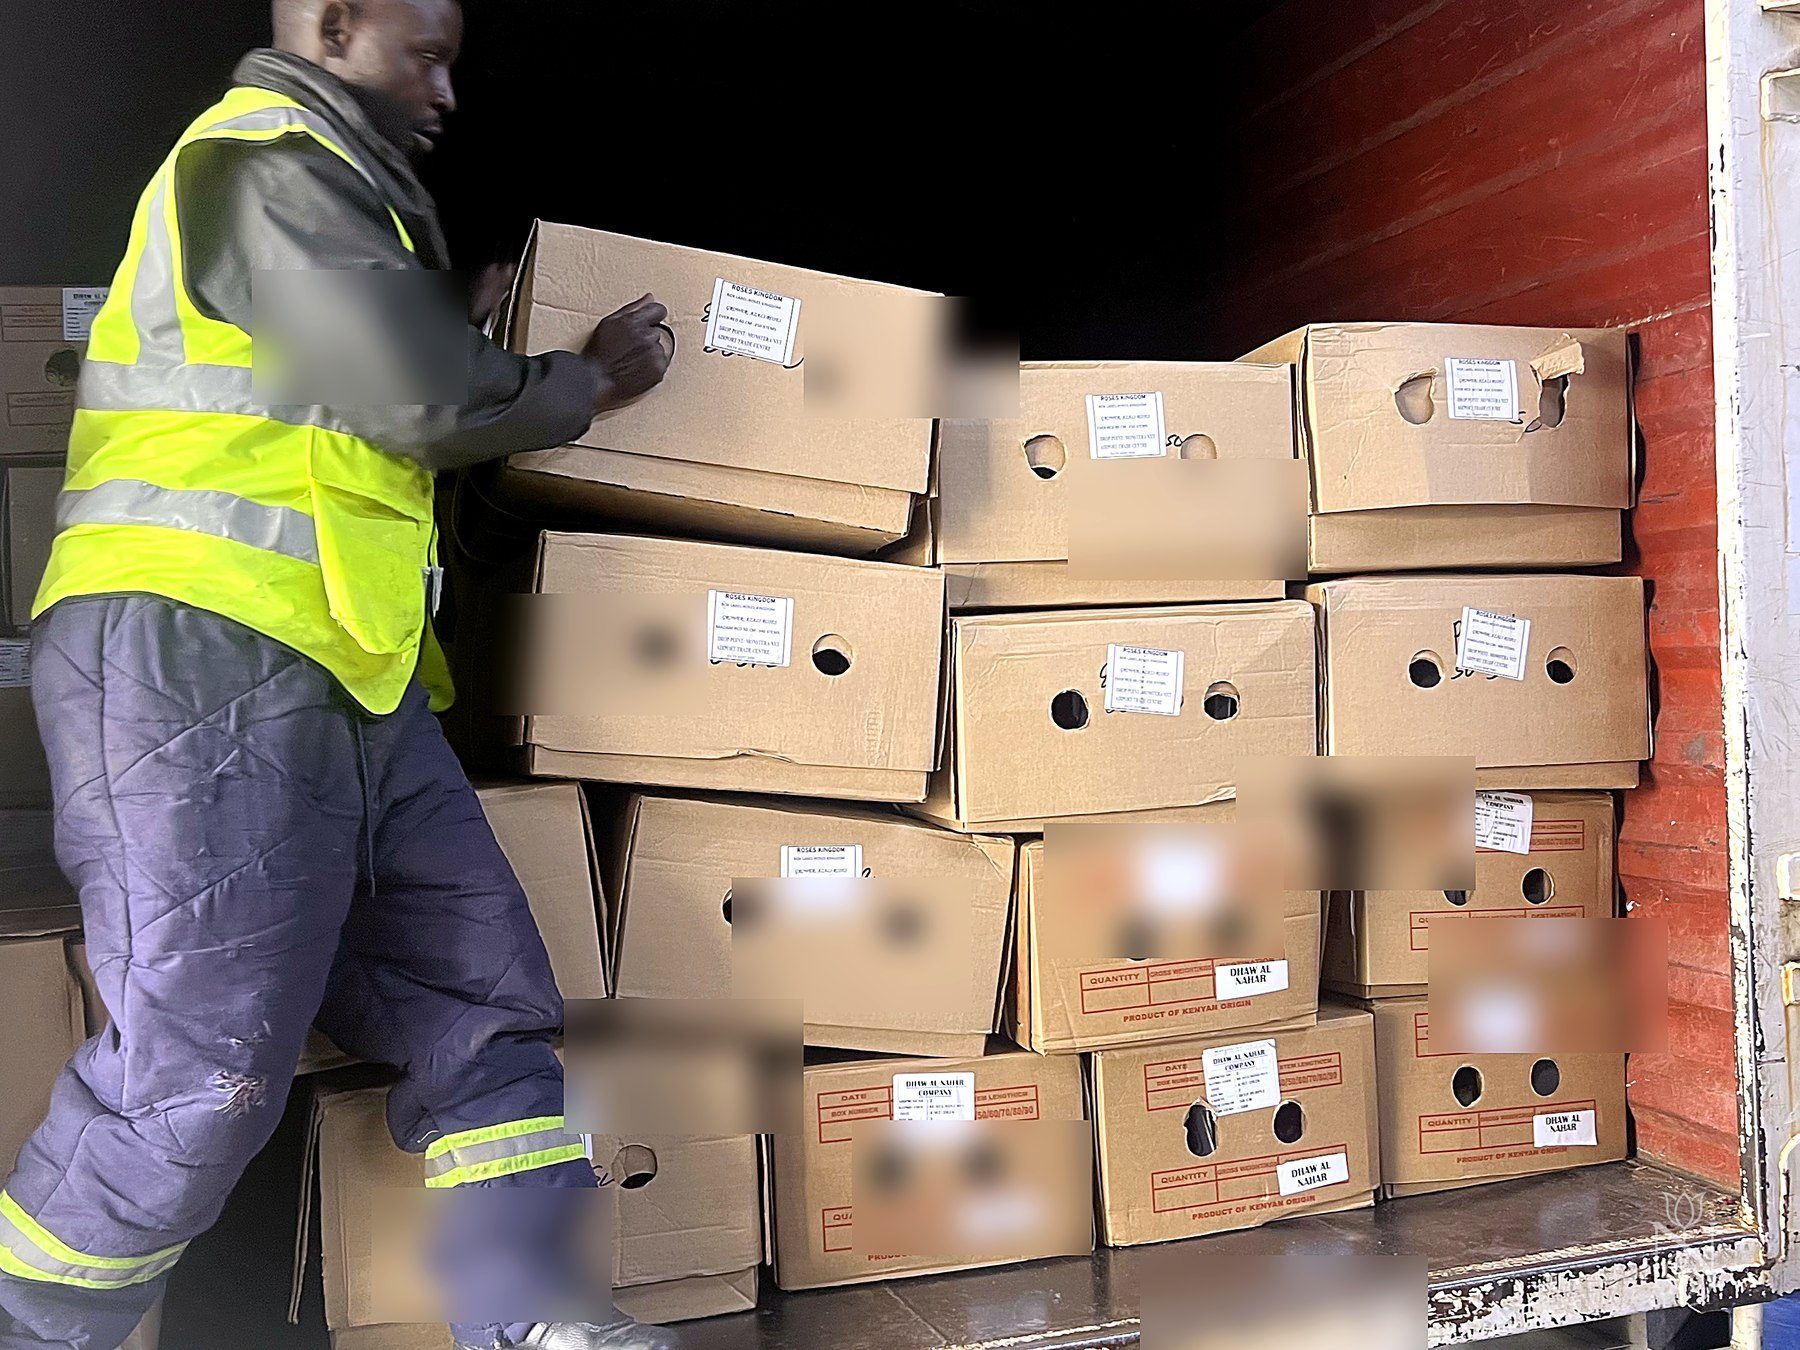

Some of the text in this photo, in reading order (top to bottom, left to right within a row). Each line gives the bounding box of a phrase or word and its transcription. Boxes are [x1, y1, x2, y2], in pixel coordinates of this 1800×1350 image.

[732, 285, 782, 302] ROSES KINGDOM
[1230, 964, 1272, 977] DHAW AL
[1090, 973, 1140, 985] QUANTITY
[1235, 974, 1267, 986] NAHAR
[1123, 1011, 1165, 1022] PRODUCT
[1182, 1004, 1218, 1015] KENYAN
[1220, 1000, 1252, 1010] ORIGIN
[1165, 1064, 1188, 1072] DATE
[1225, 1061, 1255, 1070] COMPANY
[841, 1093, 867, 1101] DATE
[1428, 1118, 1472, 1127] QUANTITY
[1545, 1114, 1581, 1125] DHAW AL
[1550, 1124, 1577, 1133] NAHAR
[1456, 1154, 1493, 1163] PRODUCT
[1291, 1162, 1331, 1178] DHAW AL
[1161, 1171, 1208, 1184] QUANTITY
[1298, 1173, 1327, 1188] NAHAR
[1192, 1208, 1234, 1220] PRODUCT
[1249, 1200, 1284, 1211] KENYAN
[1286, 1195, 1316, 1205] ORIGIN
